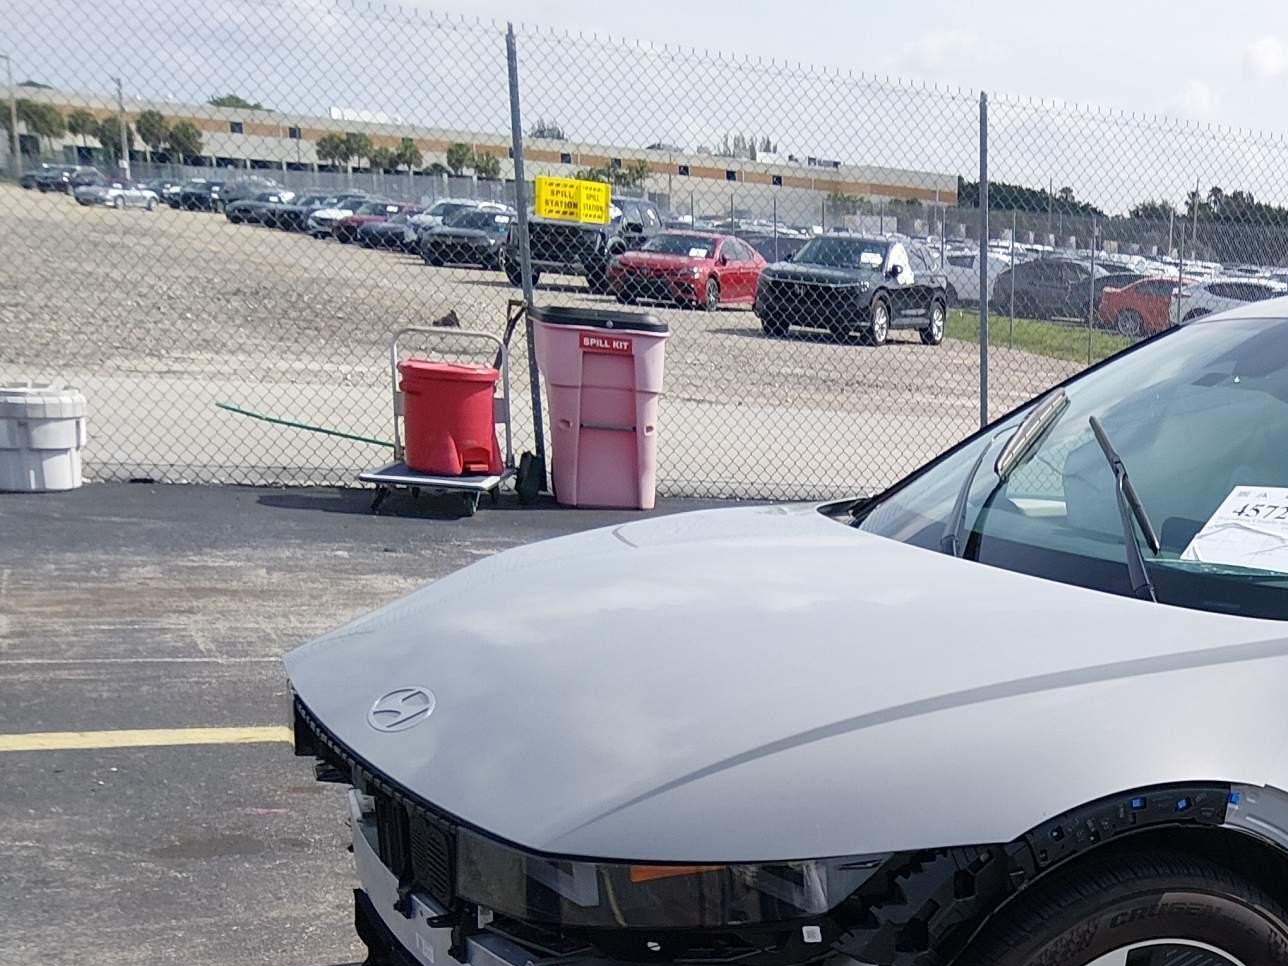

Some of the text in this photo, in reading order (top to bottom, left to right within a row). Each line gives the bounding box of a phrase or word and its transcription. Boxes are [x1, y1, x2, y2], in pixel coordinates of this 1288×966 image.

[550, 189, 574, 199] SPILL
[586, 193, 600, 202] SPILL
[545, 199, 578, 209] STATION
[584, 203, 604, 212] STATION
[583, 336, 629, 350] SPILL KIT
